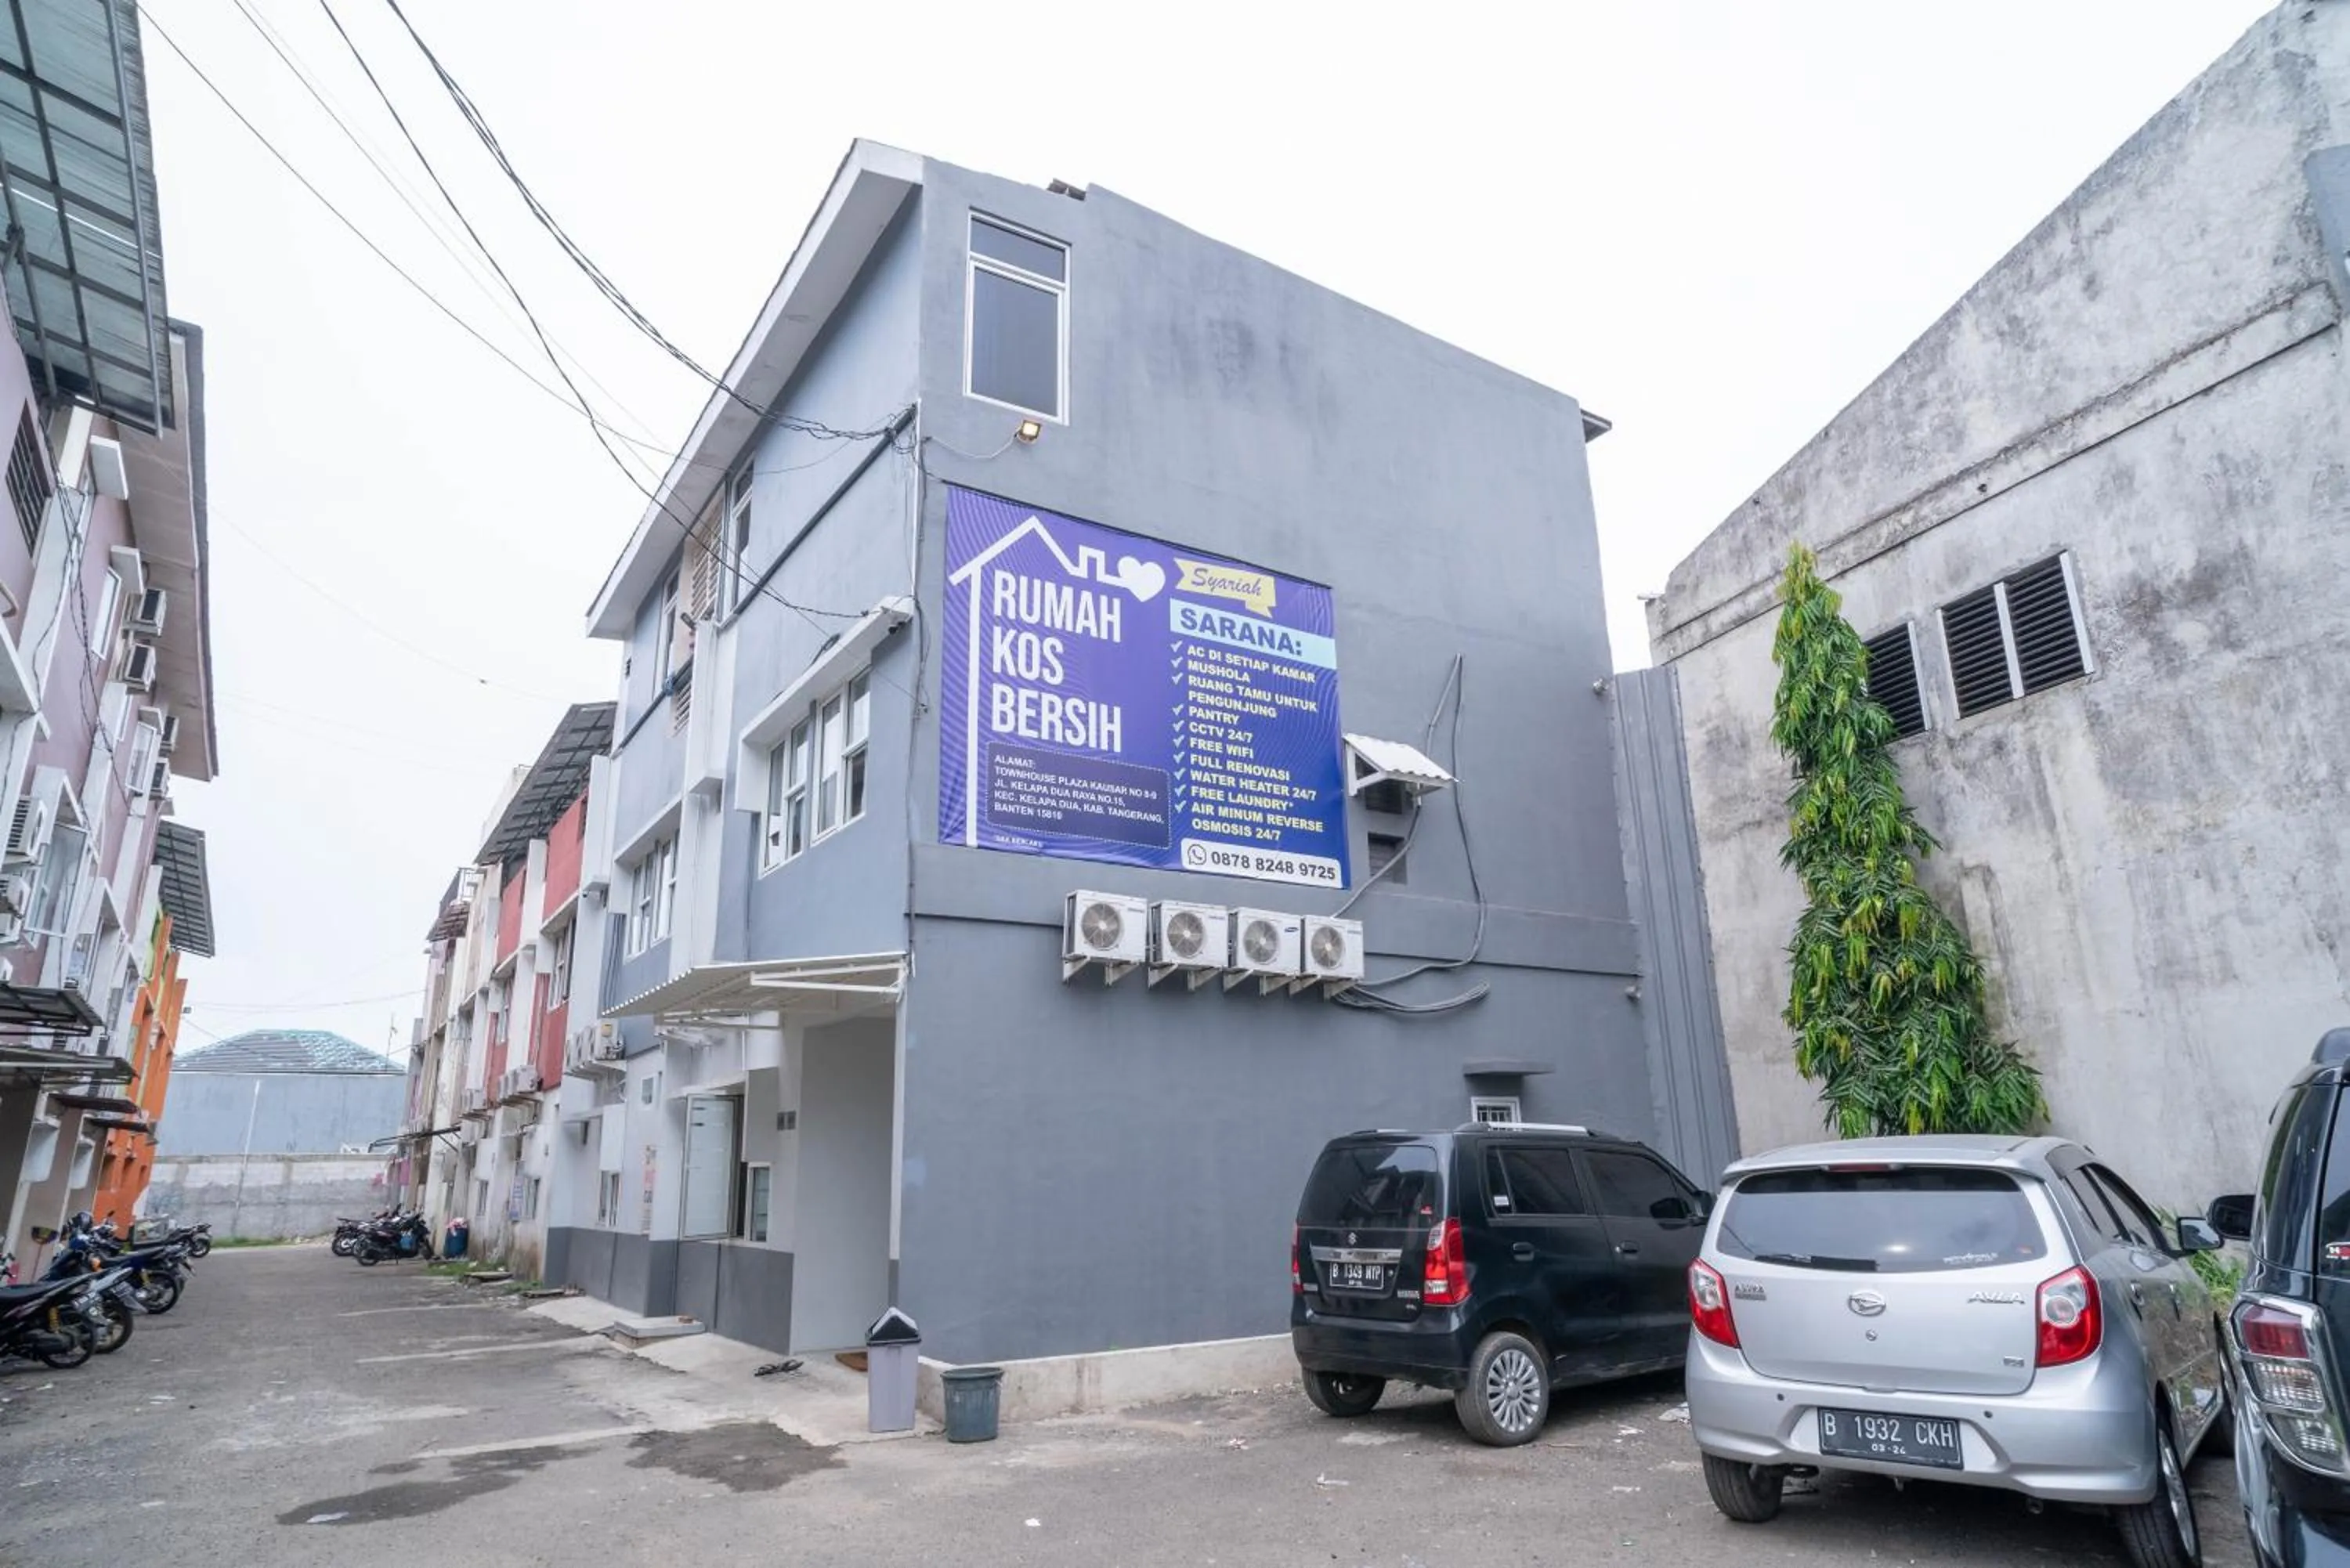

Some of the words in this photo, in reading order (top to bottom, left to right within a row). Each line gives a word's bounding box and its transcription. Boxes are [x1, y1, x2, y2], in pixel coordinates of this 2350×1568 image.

[1191, 568, 1261, 596] Syariah
[994, 569, 1121, 643] RUMAH
[1180, 608, 1303, 656] SARANA:
[992, 626, 1064, 685] KOS
[1188, 645, 1205, 658] AC
[1209, 649, 1221, 662] DI
[1226, 653, 1270, 671] SETIAP
[1273, 663, 1316, 683] KAMAR
[1188, 660, 1250, 683] MUSHOLA
[1188, 675, 1234, 693] RUANG
[1237, 685, 1271, 702] TAMU
[1275, 694, 1318, 712] UNTUK
[1188, 691, 1277, 718] PENGUNJUNG
[992, 683, 1121, 753] BERSIH
[1189, 706, 1240, 725] PANTRY
[1189, 722, 1224, 738] CCTV
[1227, 729, 1253, 742] 24/7
[994, 754, 1036, 768] ALAMAT:
[1190, 738, 1223, 753] FREE
[1226, 744, 1253, 759] WIFI
[994, 766, 1056, 783] TOWNHOUSE
[1058, 777, 1088, 789] PLAZA
[1190, 754, 1222, 769] FULL
[1227, 760, 1290, 781] RENOVASI
[994, 790, 1017, 801] KEC.
[1019, 793, 1057, 807] KELAPA
[1010, 781, 1049, 796] KELAPA
[1050, 787, 1071, 798] DUA
[1072, 790, 1096, 801] RAYA
[1190, 770, 1235, 788] WATER
[1239, 778, 1289, 797] HEATER
[1292, 787, 1317, 801] 24/7
[1191, 786, 1224, 801] FREE
[994, 802, 1033, 816] BANTEN
[1191, 802, 1214, 815] AIR
[1218, 806, 1264, 823] MINUM
[1267, 814, 1324, 833] REVERSE
[1191, 818, 1253, 837] OSMOSIS
[1256, 828, 1281, 841] 24/7
[1211, 851, 1250, 869] 0878
[1256, 858, 1294, 875] 8248
[1300, 862, 1336, 880] 9725
[1332, 1263, 1339, 1278] B
[1824, 1413, 1837, 1436] B
[1854, 1415, 1902, 1442] 1932
[1915, 1422, 1954, 1447] CKH
